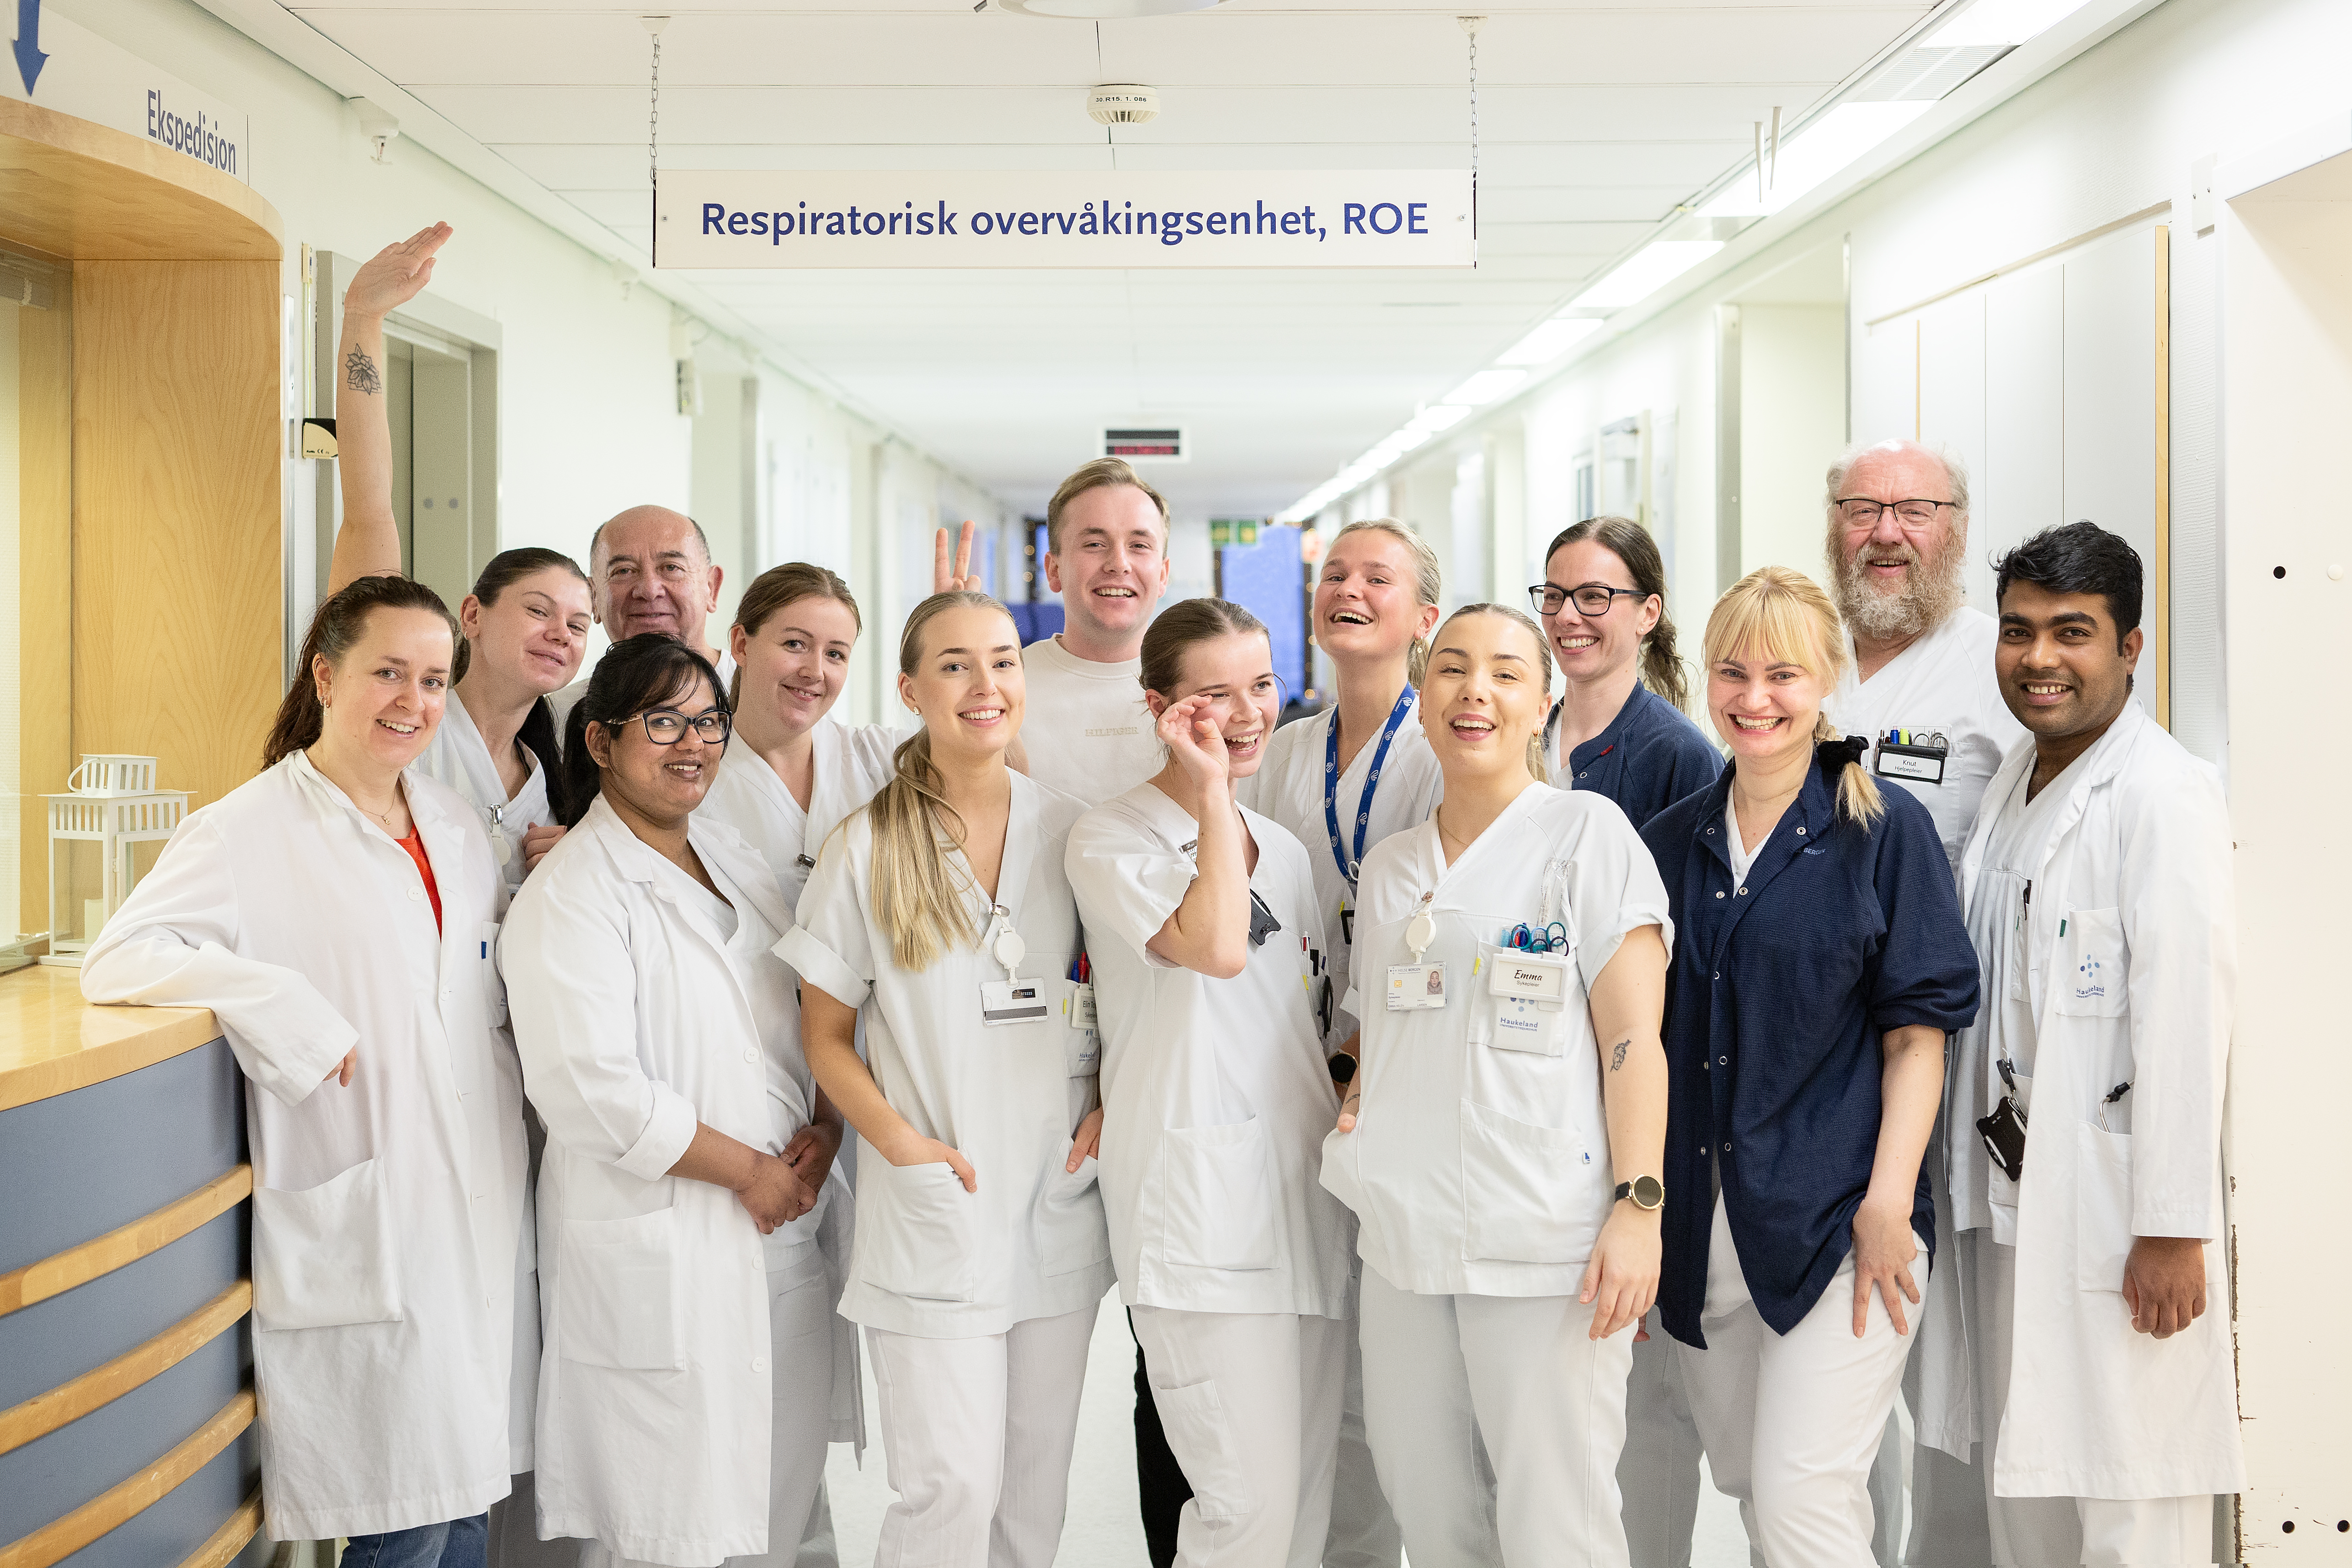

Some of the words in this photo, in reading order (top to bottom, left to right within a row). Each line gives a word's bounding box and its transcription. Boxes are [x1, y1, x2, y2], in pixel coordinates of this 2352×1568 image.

[703, 200, 958, 246] Respiratorisk
[971, 200, 1326, 246] overvåkingsenhet,
[1344, 203, 1428, 234] ROE
[1085, 727, 1139, 736] HILFIGER
[1514, 970, 1543, 981] Emma
[2076, 985, 2105, 995] Haukeland
[1500, 1017, 1538, 1028] Haukeland
